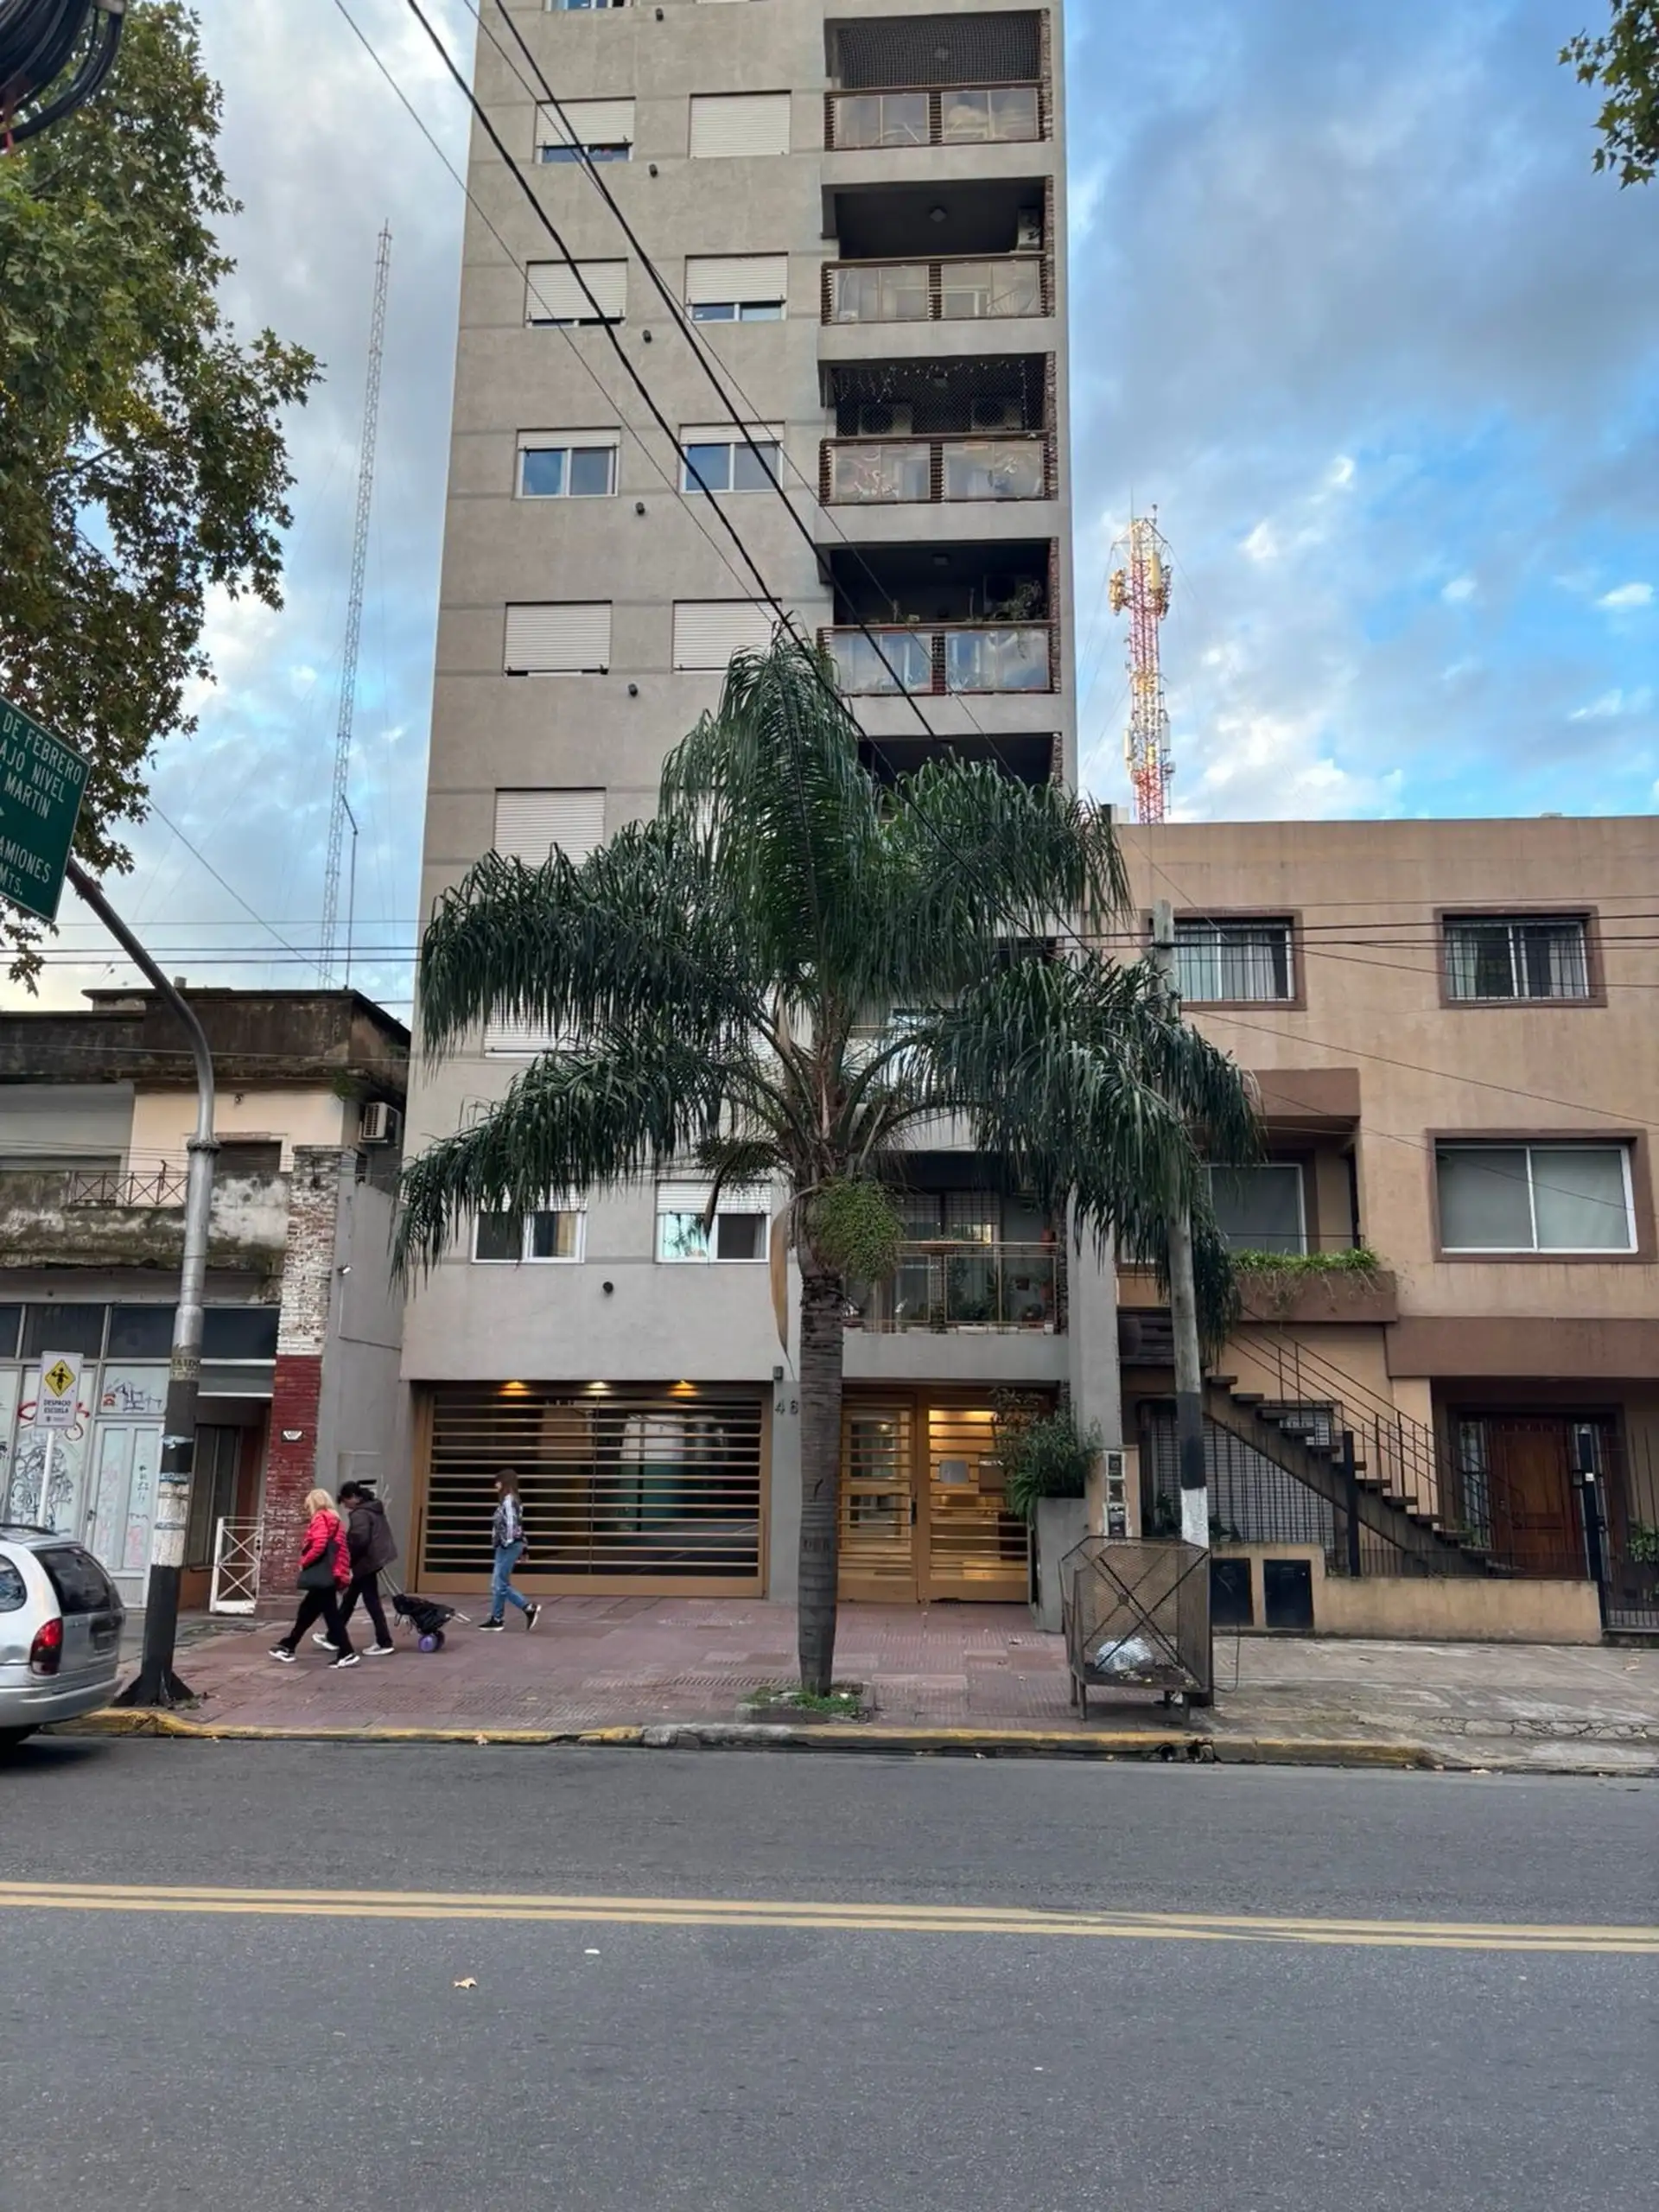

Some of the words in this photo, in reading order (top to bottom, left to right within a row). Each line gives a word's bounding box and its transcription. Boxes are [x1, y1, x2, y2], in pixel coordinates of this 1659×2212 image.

[3, 711, 22, 741] DE
[24, 728, 82, 785] FEBRERO
[4, 772, 51, 819] MARTIN
[31, 762, 65, 804] NIVEL
